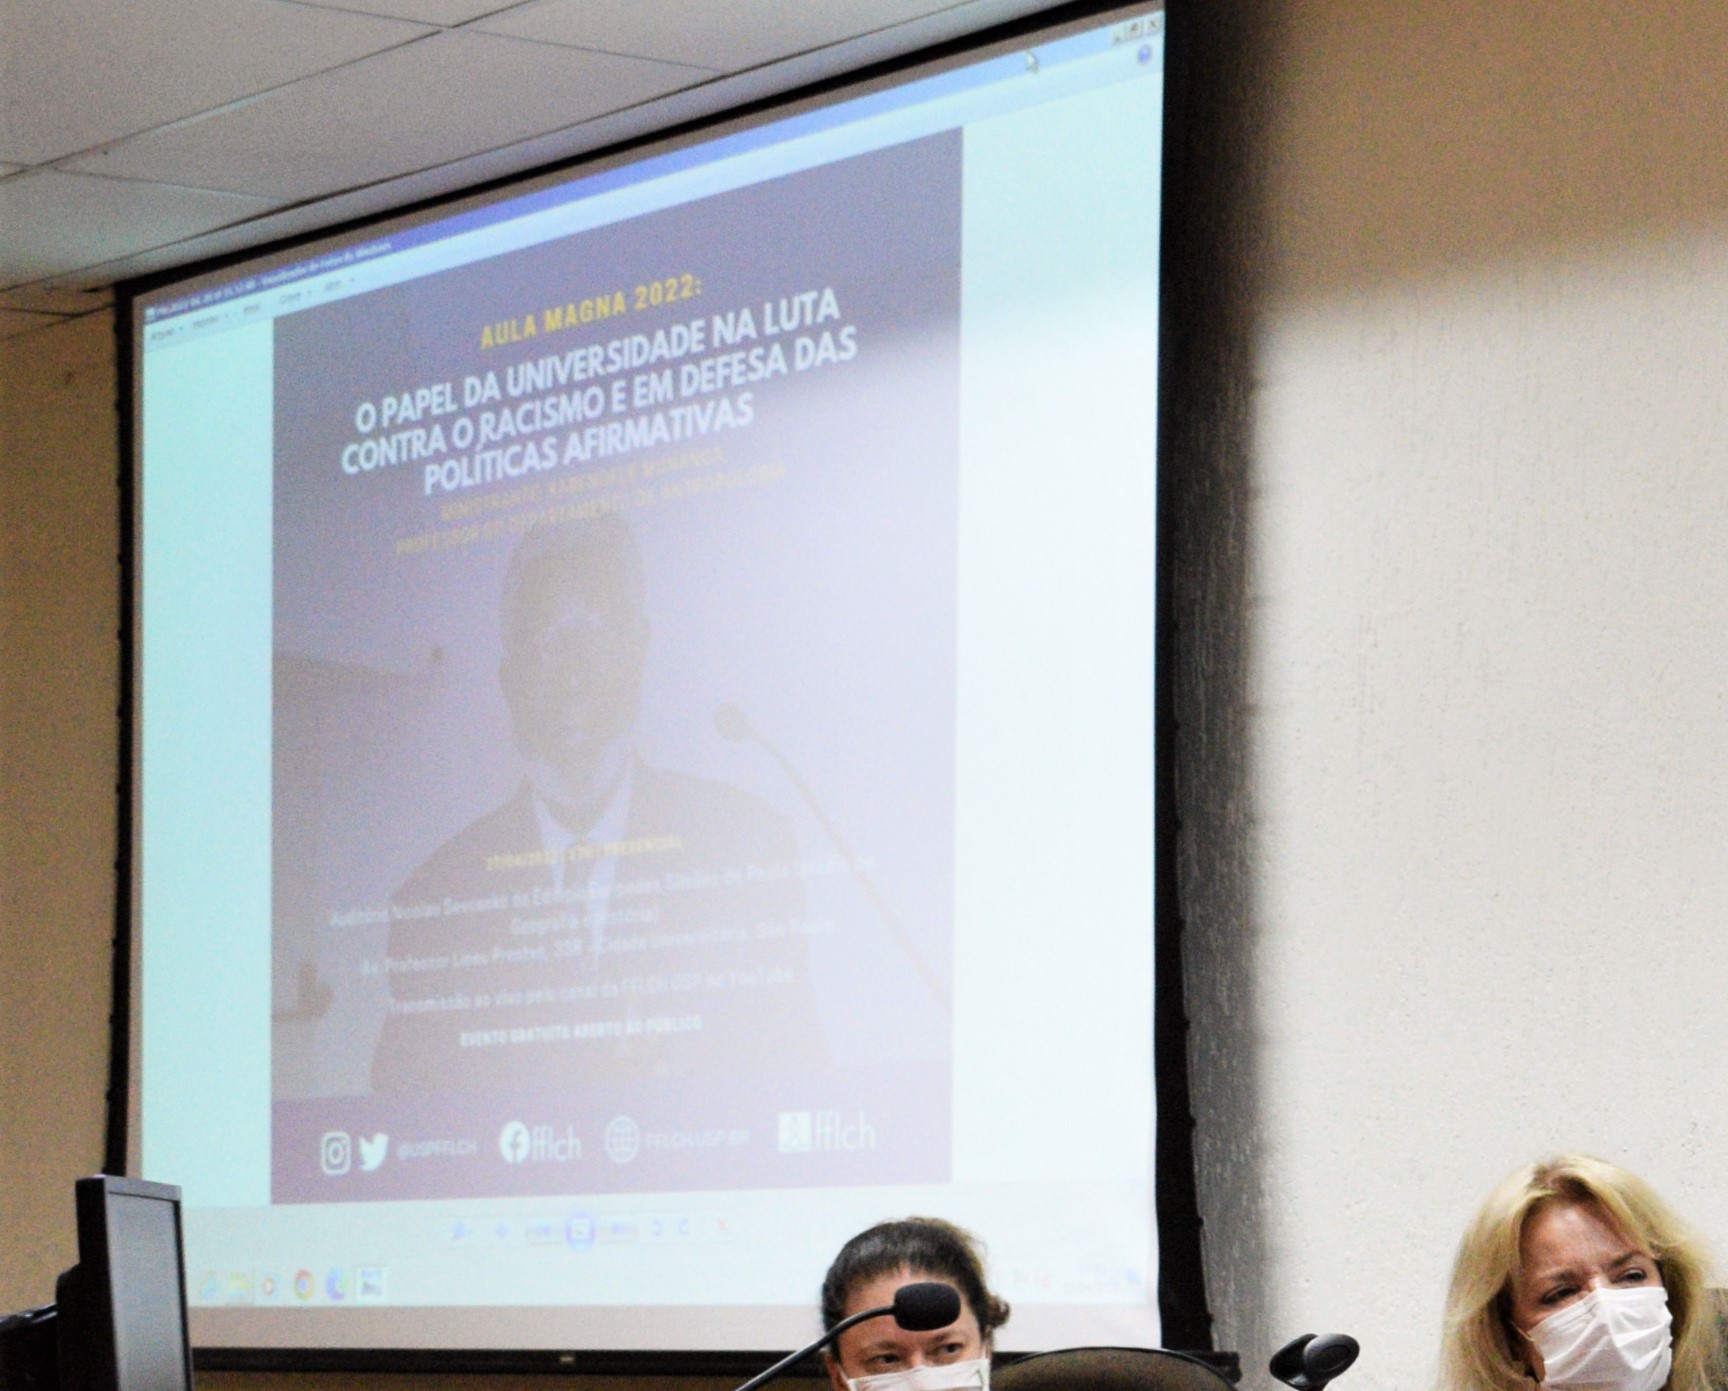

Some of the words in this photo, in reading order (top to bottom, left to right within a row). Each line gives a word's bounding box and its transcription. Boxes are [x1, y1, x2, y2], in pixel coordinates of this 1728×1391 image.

[355, 402, 377, 433] O
[382, 381, 457, 428] PAPEL
[464, 371, 501, 408] DA
[507, 320, 706, 396] UNIVERSIDADE
[713, 307, 758, 347] NA
[764, 287, 841, 335] LUTA
[481, 314, 537, 349] AULA
[544, 291, 626, 333] MAGNA
[634, 273, 702, 311] 2022:
[341, 424, 448, 475] CONTRA
[452, 417, 474, 449] O
[478, 386, 605, 448] RACISMO
[611, 380, 627, 413] E
[634, 369, 674, 408] EM
[680, 343, 788, 396] DEFESA
[795, 325, 858, 372] DAS
[424, 437, 558, 495] POLÍTICAS
[563, 391, 755, 466] AFIRMATIVAS
